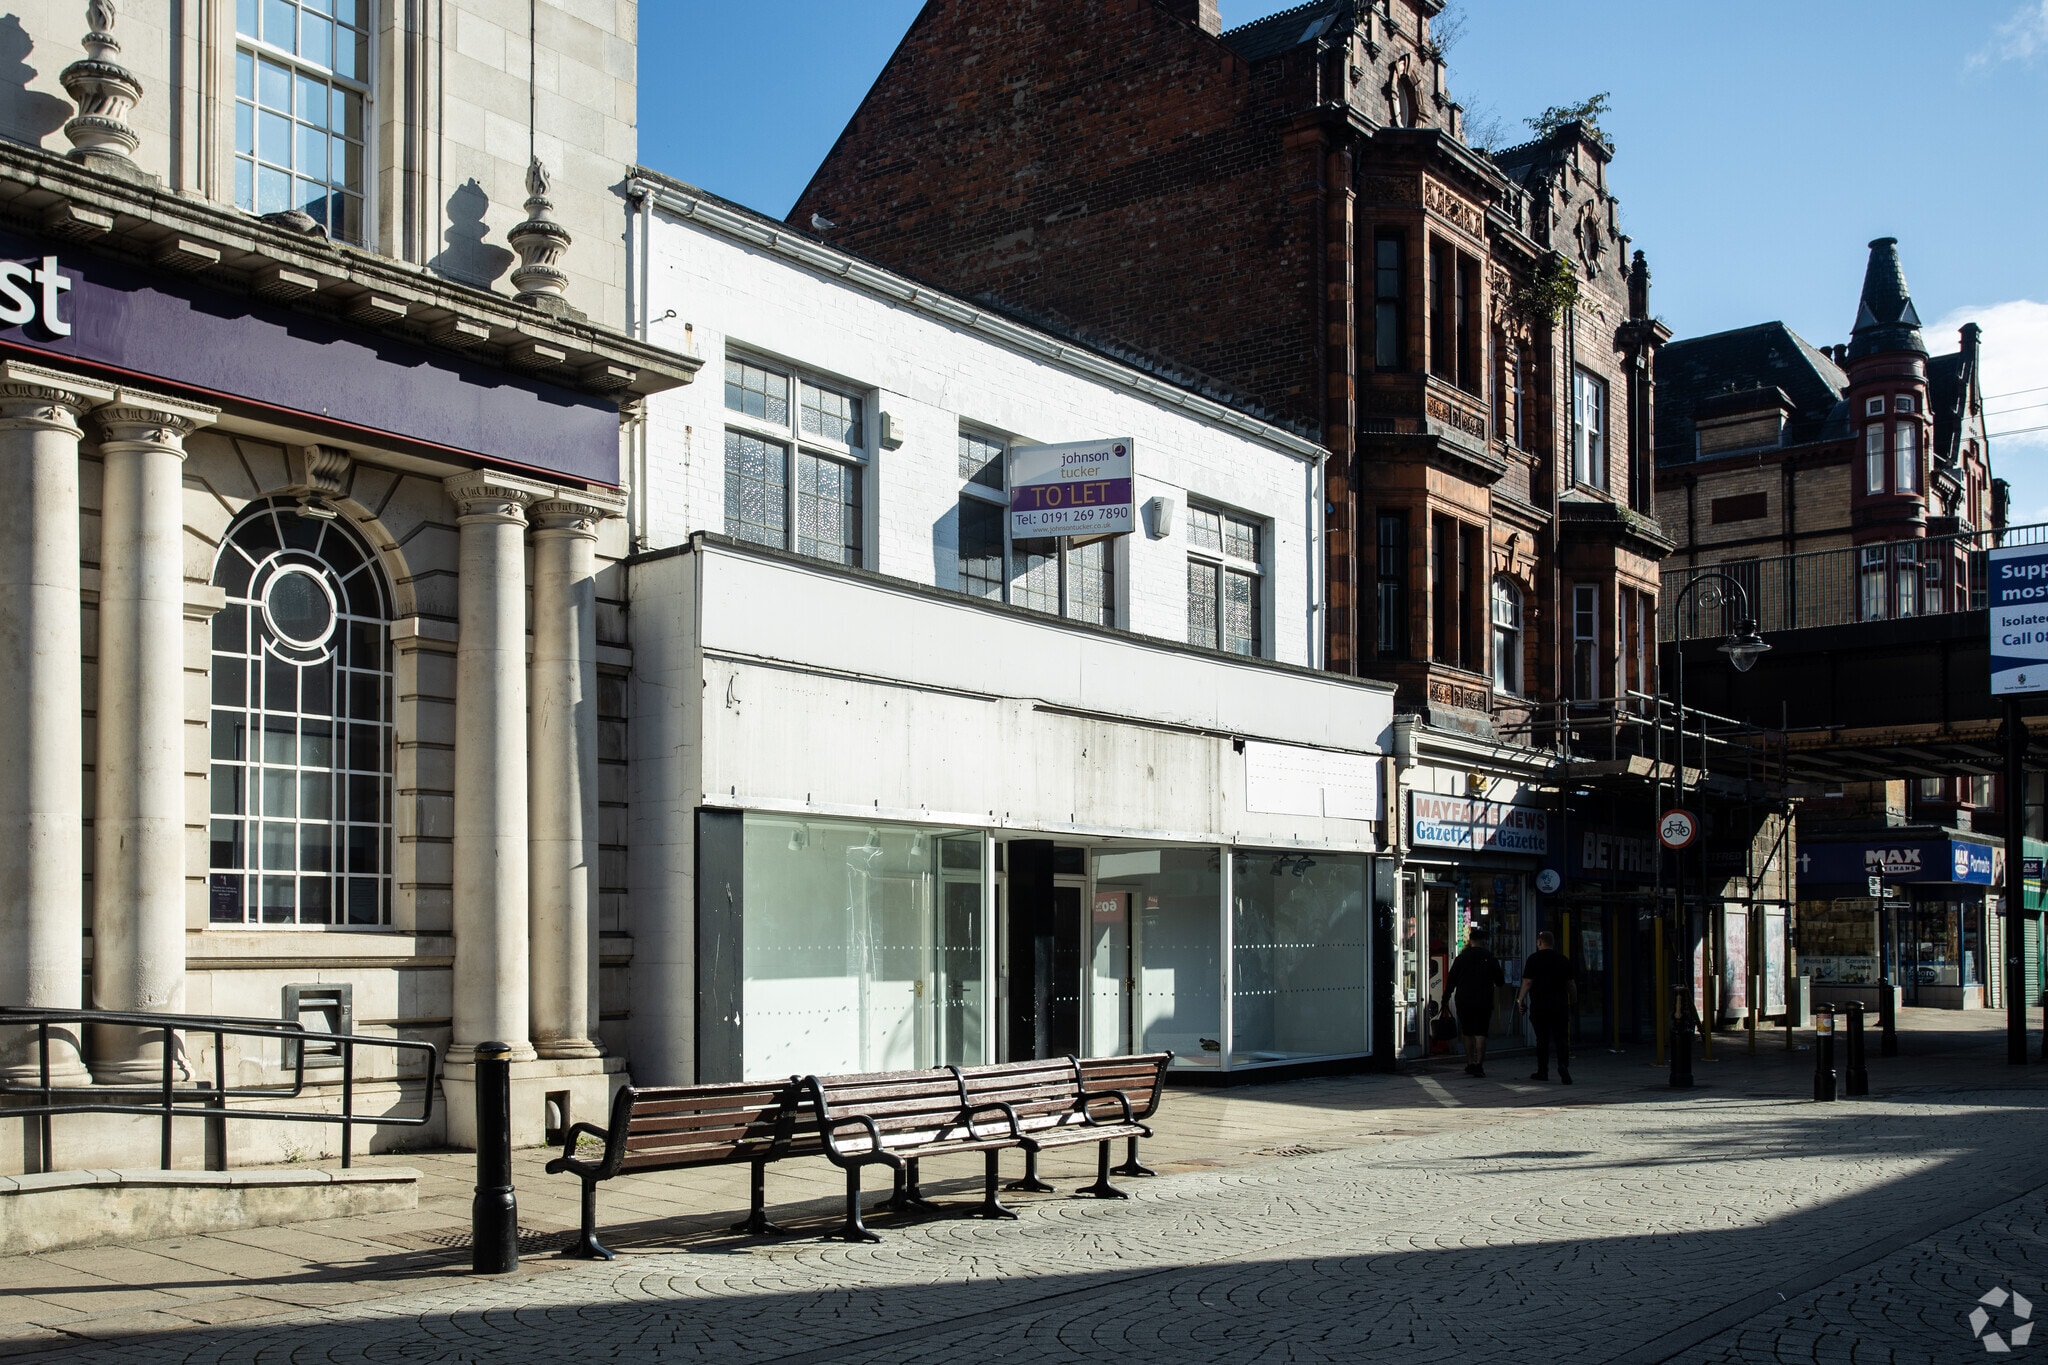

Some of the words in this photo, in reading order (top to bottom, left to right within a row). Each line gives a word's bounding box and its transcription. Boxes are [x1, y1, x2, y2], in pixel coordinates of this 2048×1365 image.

[1061, 452, 1109, 467] johnson
[1061, 466, 1100, 479] tucker
[1030, 485, 1062, 507] TO
[1070, 482, 1111, 505] LET
[1016, 513, 1037, 526] Tel:
[1041, 511, 1068, 524] 0191
[1073, 509, 1094, 522] 269
[1099, 506, 1128, 520] 7890
[1032, 521, 1112, 534] www.johnsontucker.co.uk
[2002, 614, 2048, 627] Isolate
[2002, 631, 2031, 646] Call
[1505, 808, 1546, 832] NEWS
[1416, 820, 1471, 844] Gazette
[1498, 829, 1546, 851] Gazette
[1865, 848, 1921, 864] MAX
[1955, 849, 1969, 865] MAX
[1970, 854, 1990, 874] Portraits
